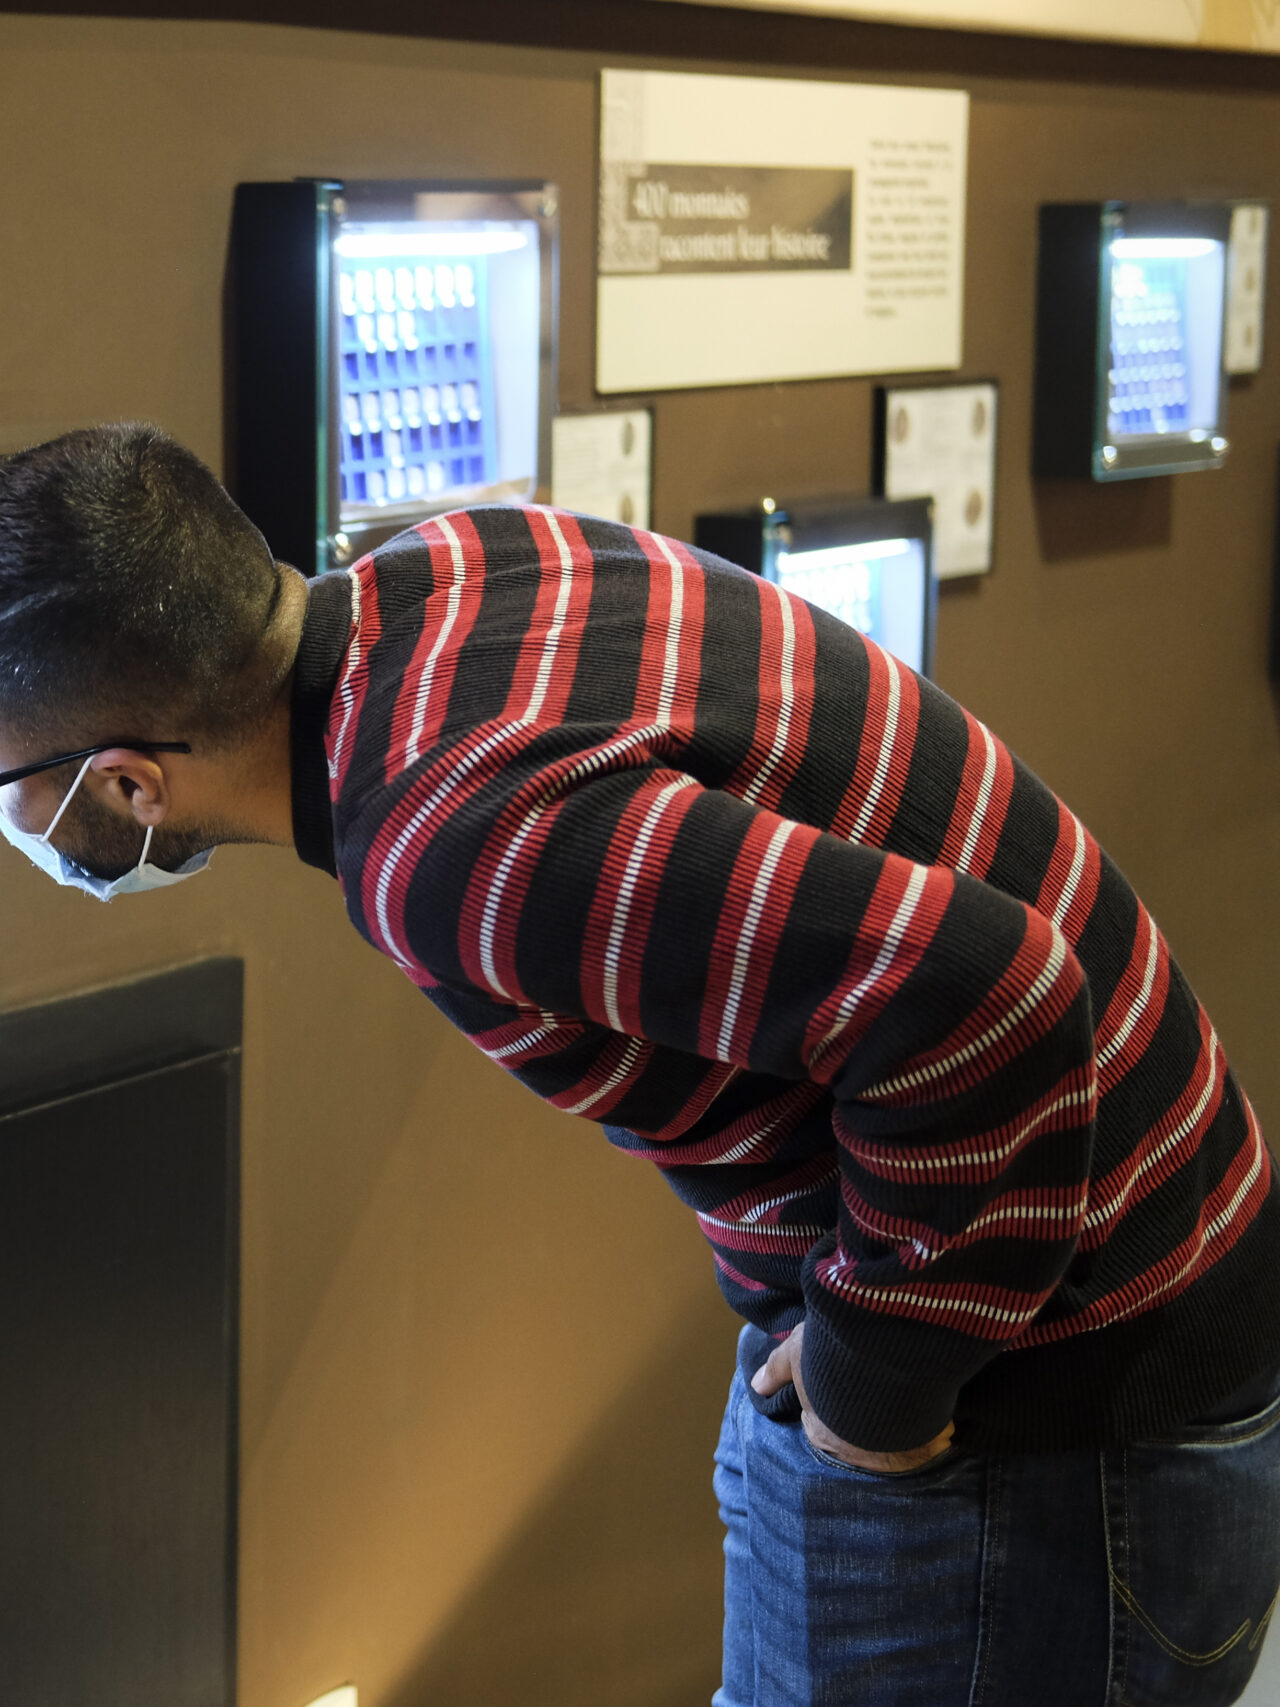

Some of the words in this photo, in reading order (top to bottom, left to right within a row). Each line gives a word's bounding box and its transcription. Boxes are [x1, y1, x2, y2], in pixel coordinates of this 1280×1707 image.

[633, 181, 669, 218] 400
[670, 186, 750, 219] monnaies
[660, 232, 736, 261] racontent
[737, 225, 769, 261] leur
[771, 225, 830, 261] histoire
